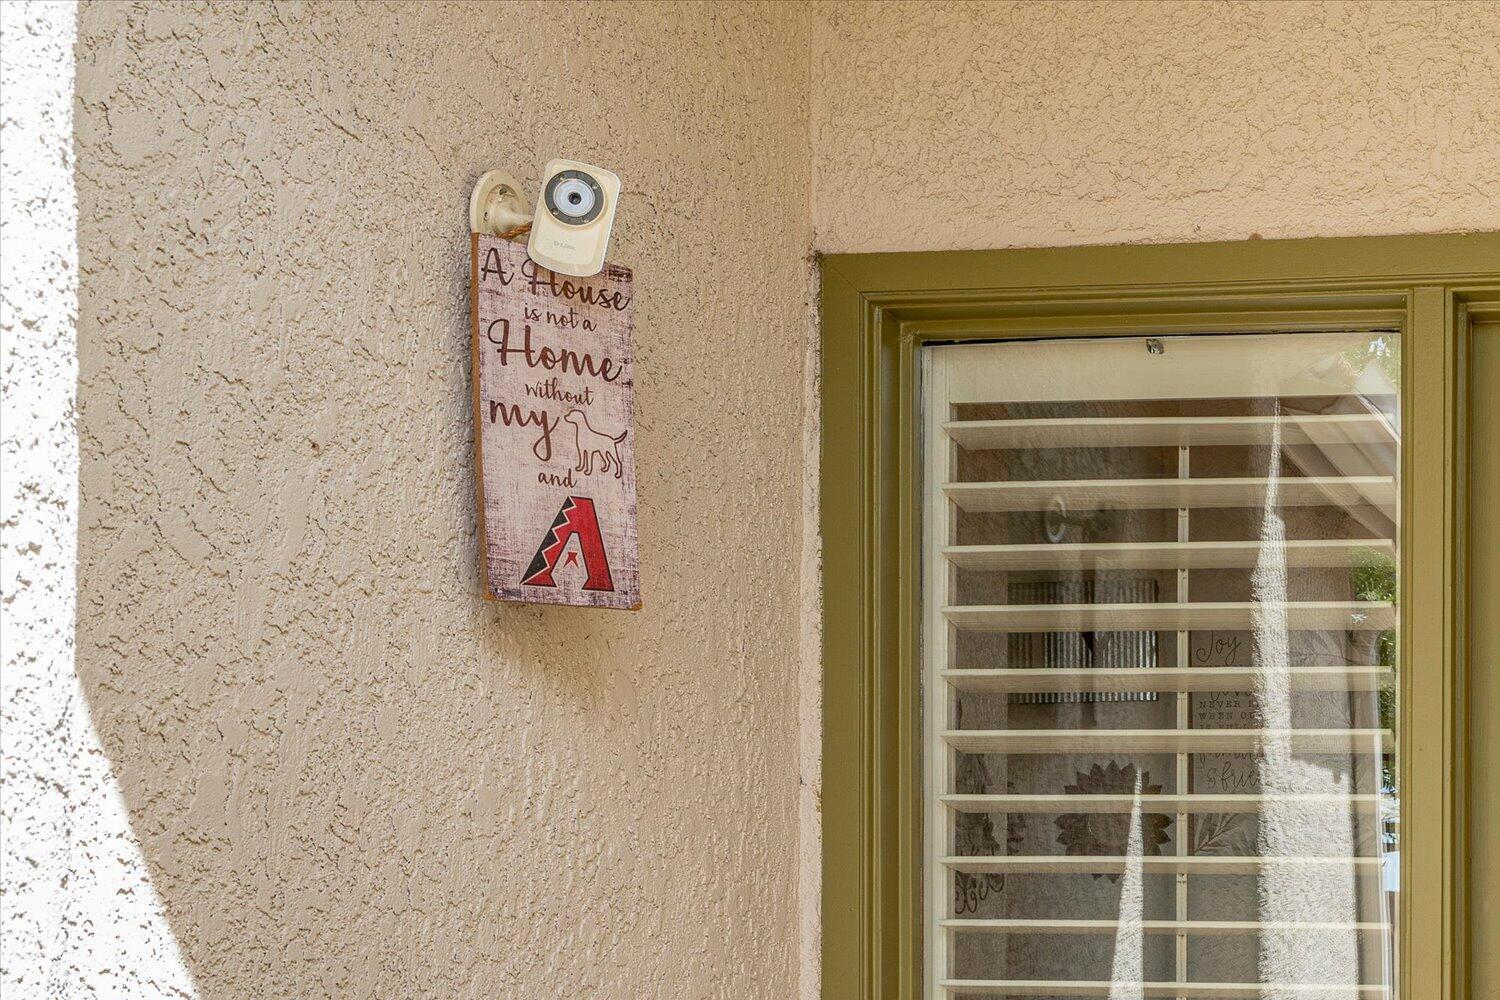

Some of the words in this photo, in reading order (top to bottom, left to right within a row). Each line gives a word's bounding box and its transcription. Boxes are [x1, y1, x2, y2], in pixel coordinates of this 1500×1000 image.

[481, 247, 515, 286] A
[521, 258, 631, 311] House
[524, 303, 542, 321] is
[547, 307, 579, 329] not
[582, 319, 597, 332] a
[487, 318, 623, 382] Home
[525, 377, 594, 406] without
[490, 400, 560, 462] my
[538, 468, 577, 489] and
[1196, 630, 1242, 667] Joy
[1199, 711, 1233, 720] WHEN
[1200, 700, 1241, 709] NEVER
